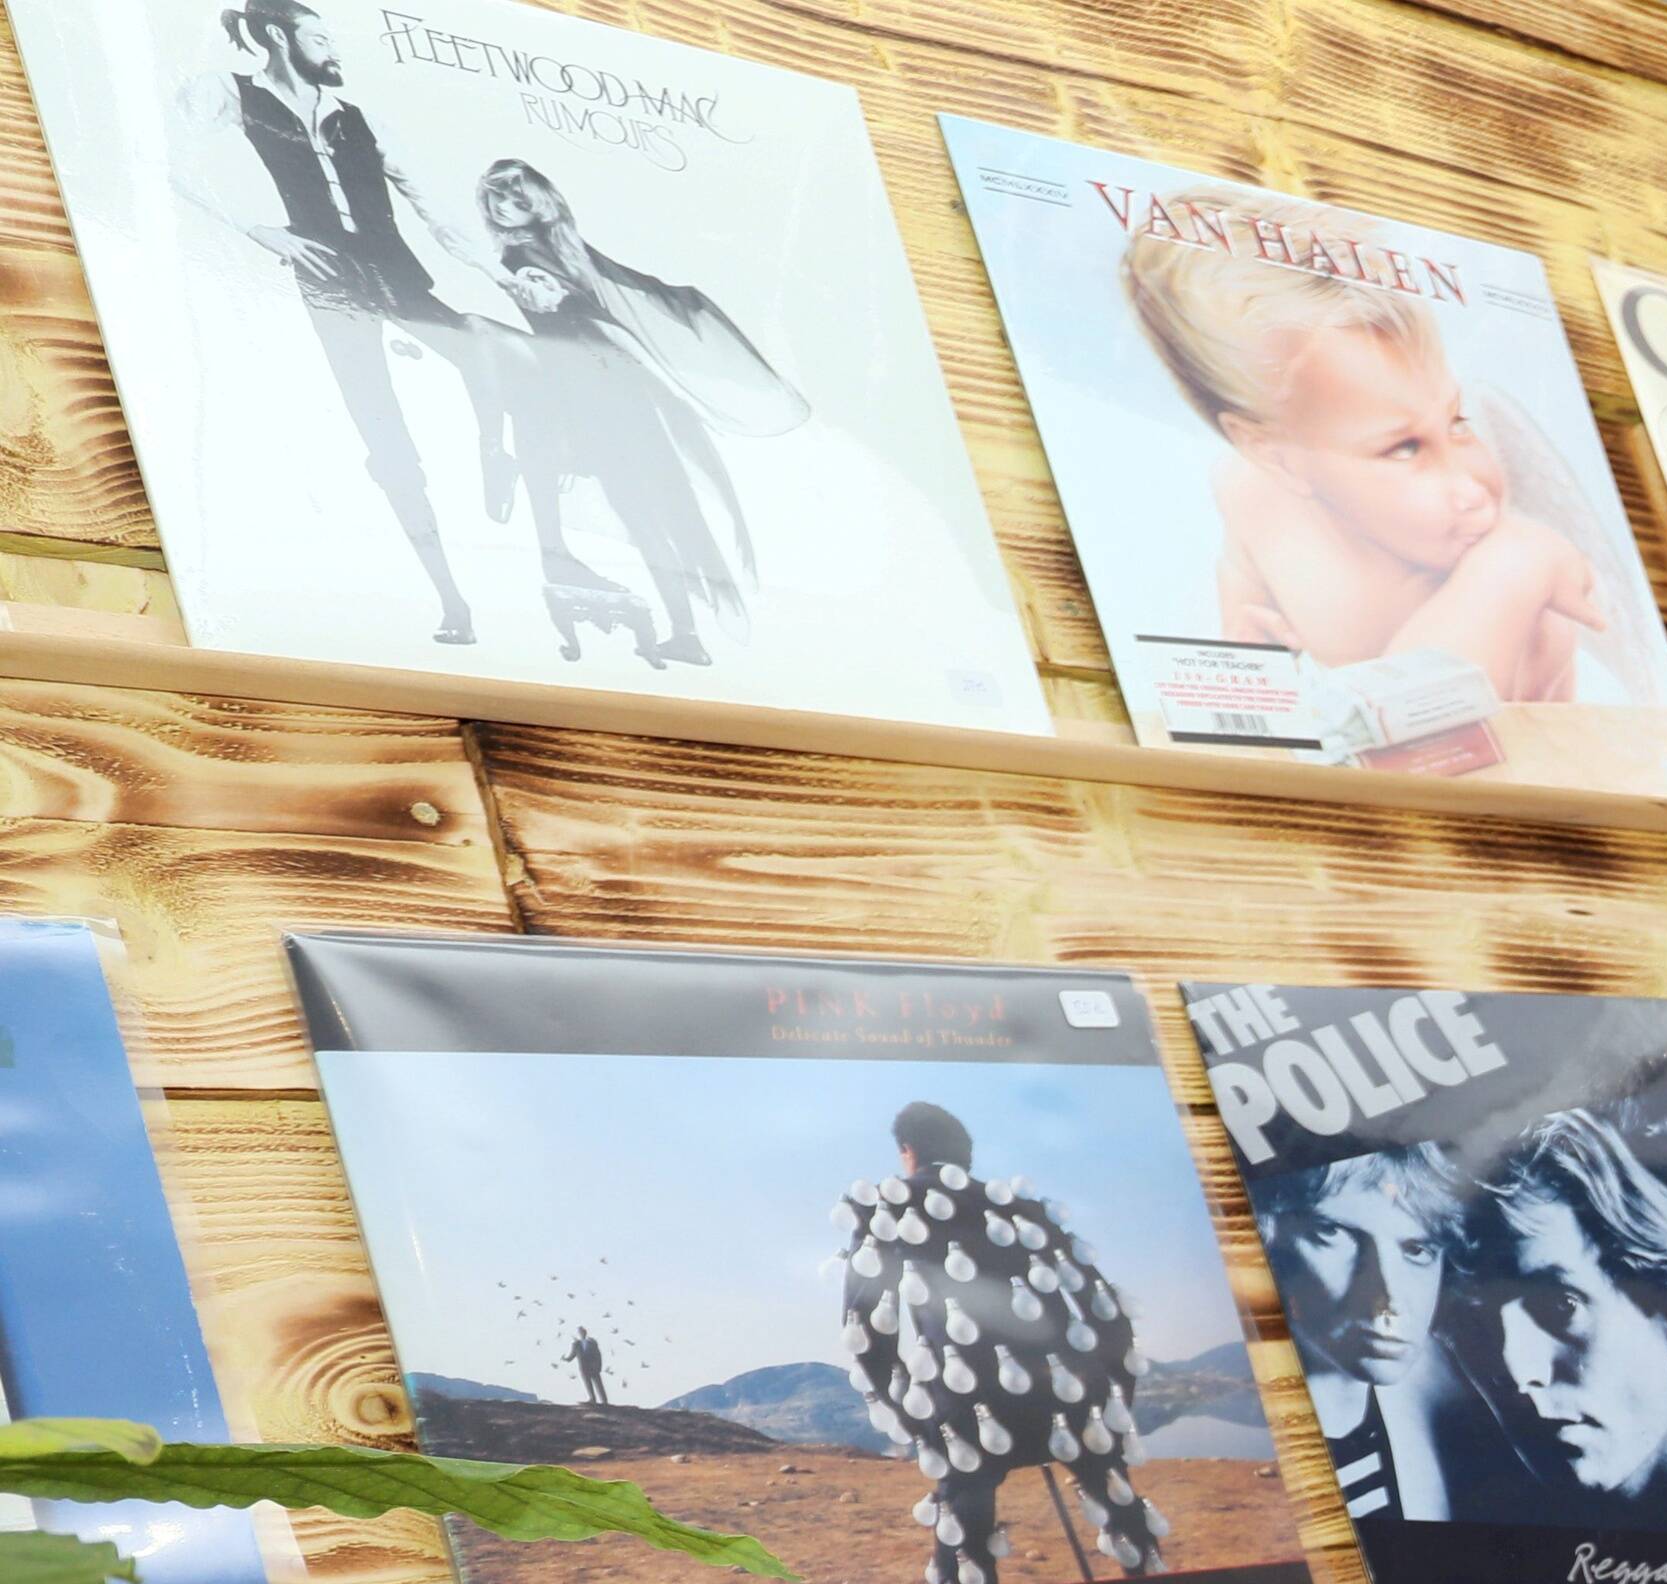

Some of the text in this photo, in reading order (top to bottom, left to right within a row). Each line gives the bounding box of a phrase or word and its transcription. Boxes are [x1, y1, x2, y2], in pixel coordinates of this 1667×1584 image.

[380, 10, 628, 107] FLEETWOOD
[519, 93, 687, 172] RUMOURS
[1086, 180, 1467, 306] VAN HALEN
[1190, 983, 1302, 1056] THE
[1206, 991, 1508, 1166] POLICE
